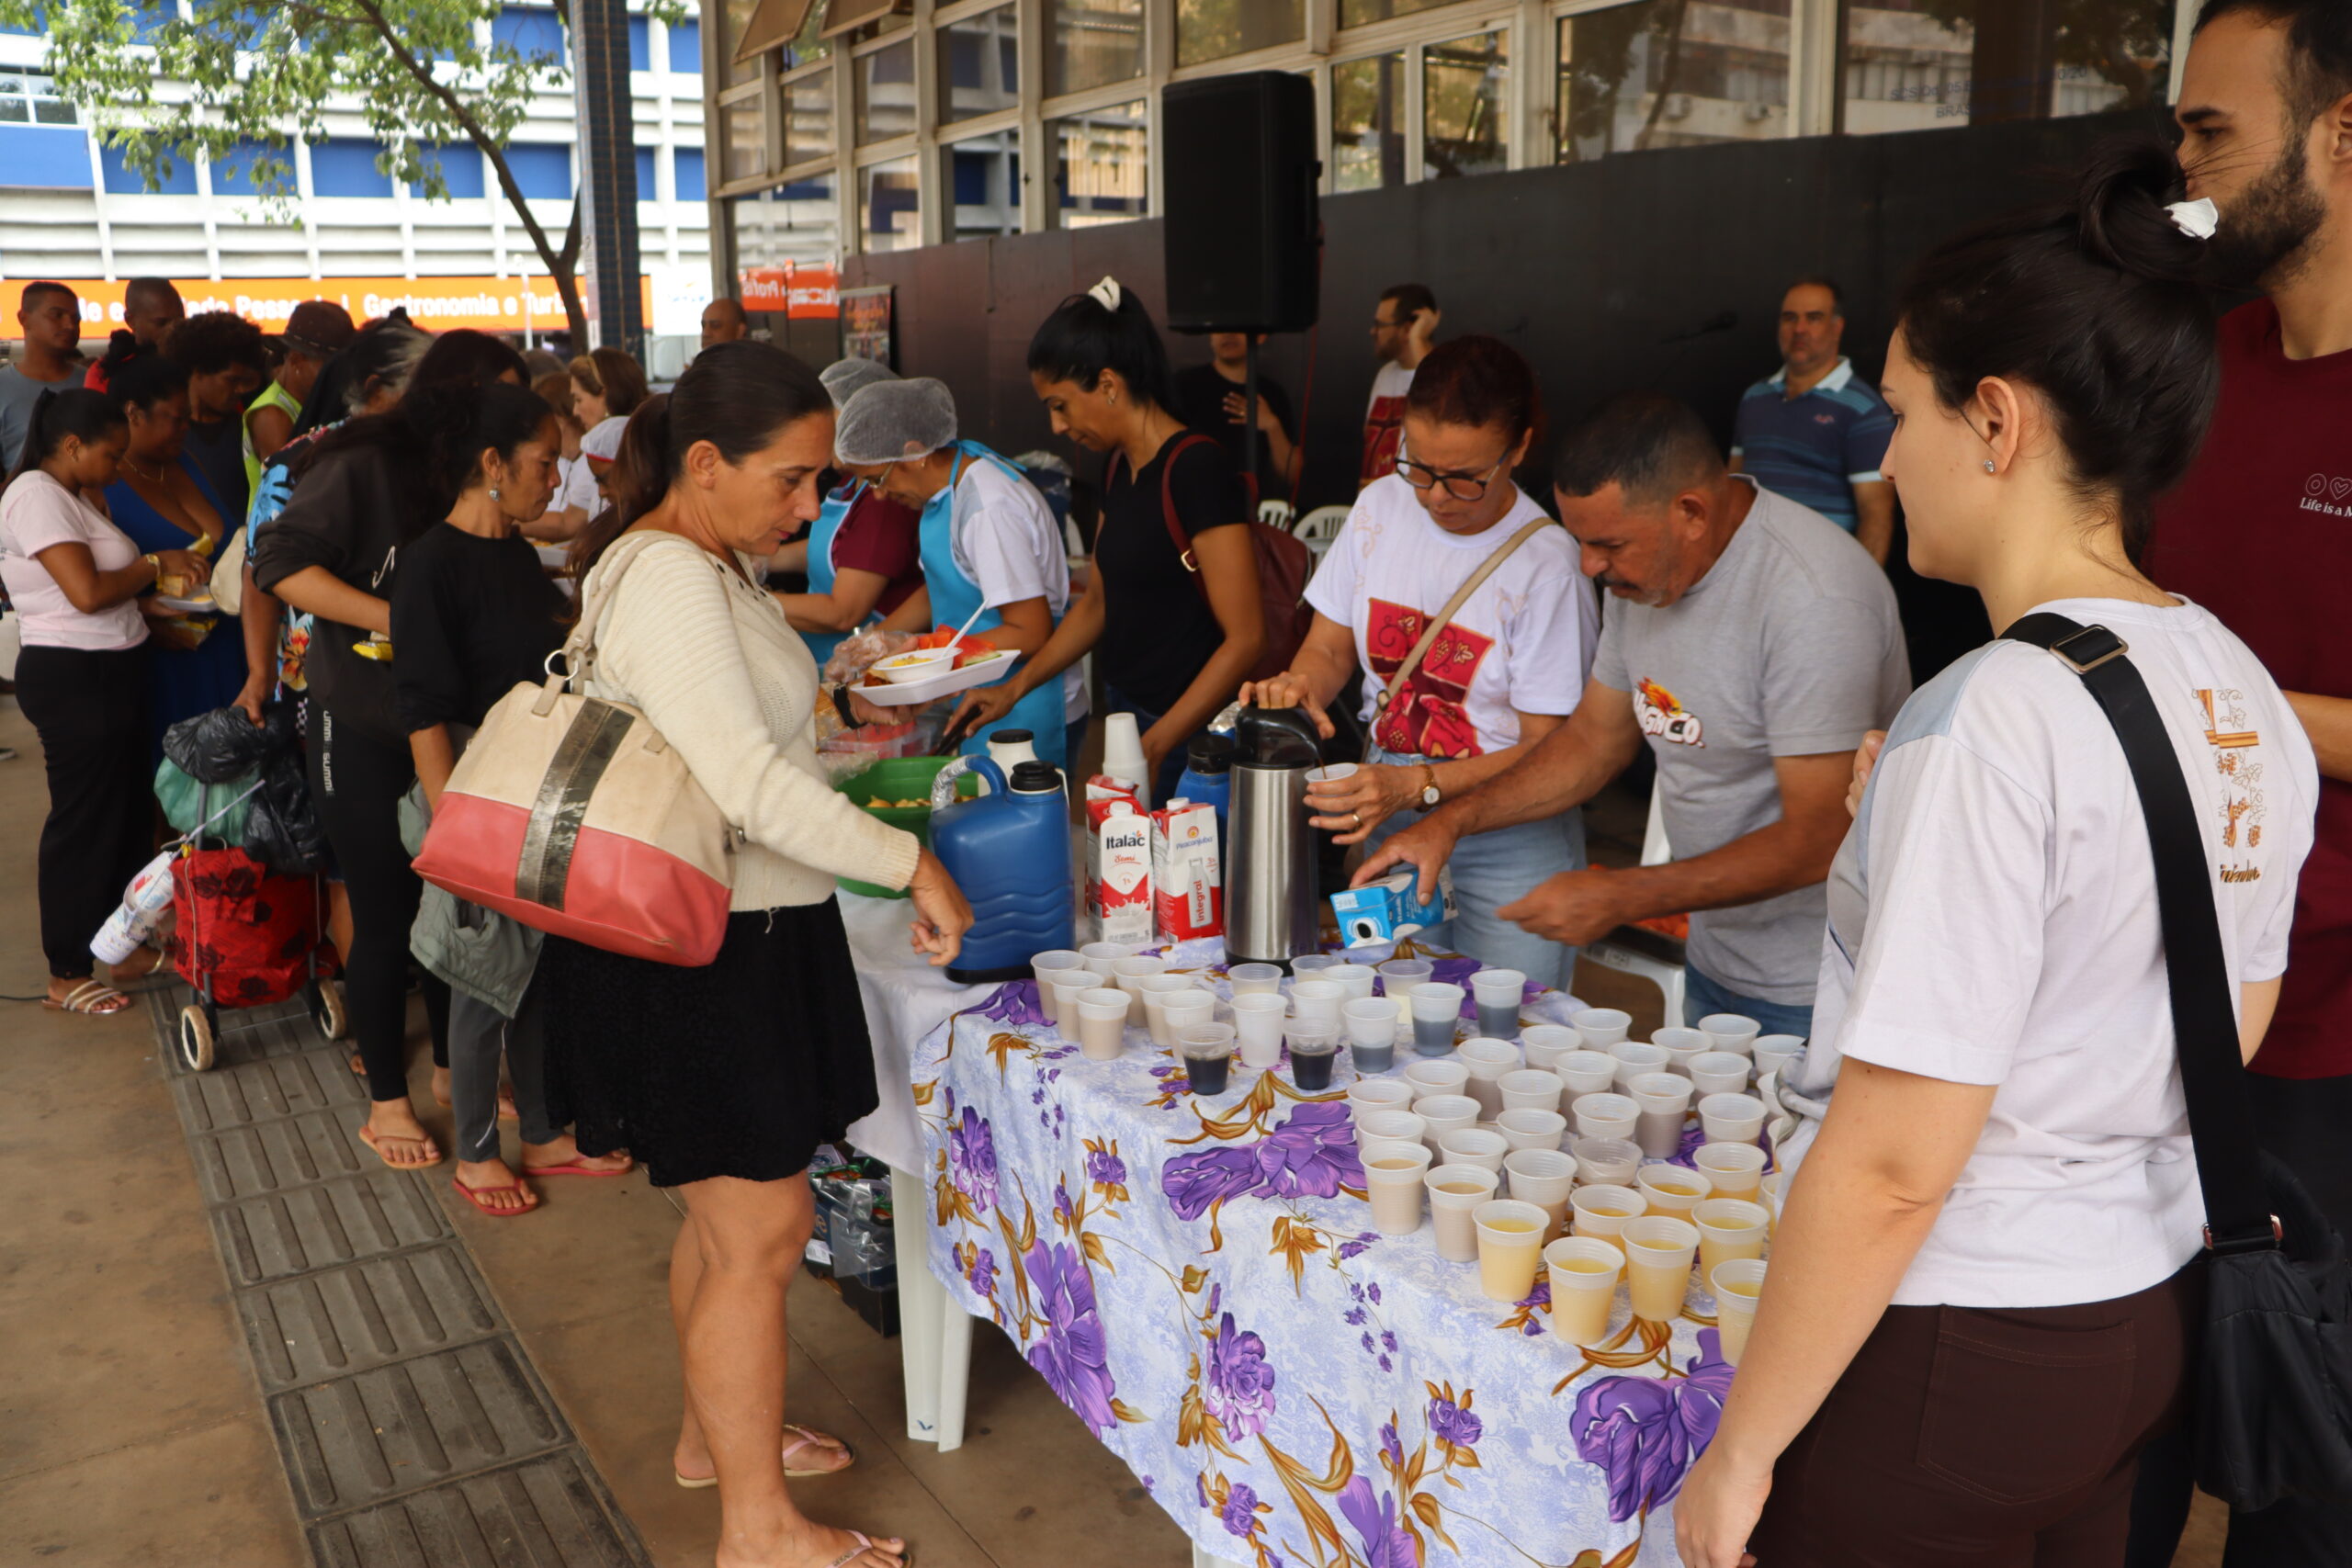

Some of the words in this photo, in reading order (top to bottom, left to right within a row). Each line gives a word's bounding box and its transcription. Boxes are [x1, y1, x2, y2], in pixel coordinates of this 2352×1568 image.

[503, 298, 517, 316] e
[2300, 497, 2323, 512] Life
[2323, 502, 2335, 514] is
[2335, 506, 2343, 515] a
[2344, 505, 2352, 517] M
[1106, 834, 1146, 850] Italac
